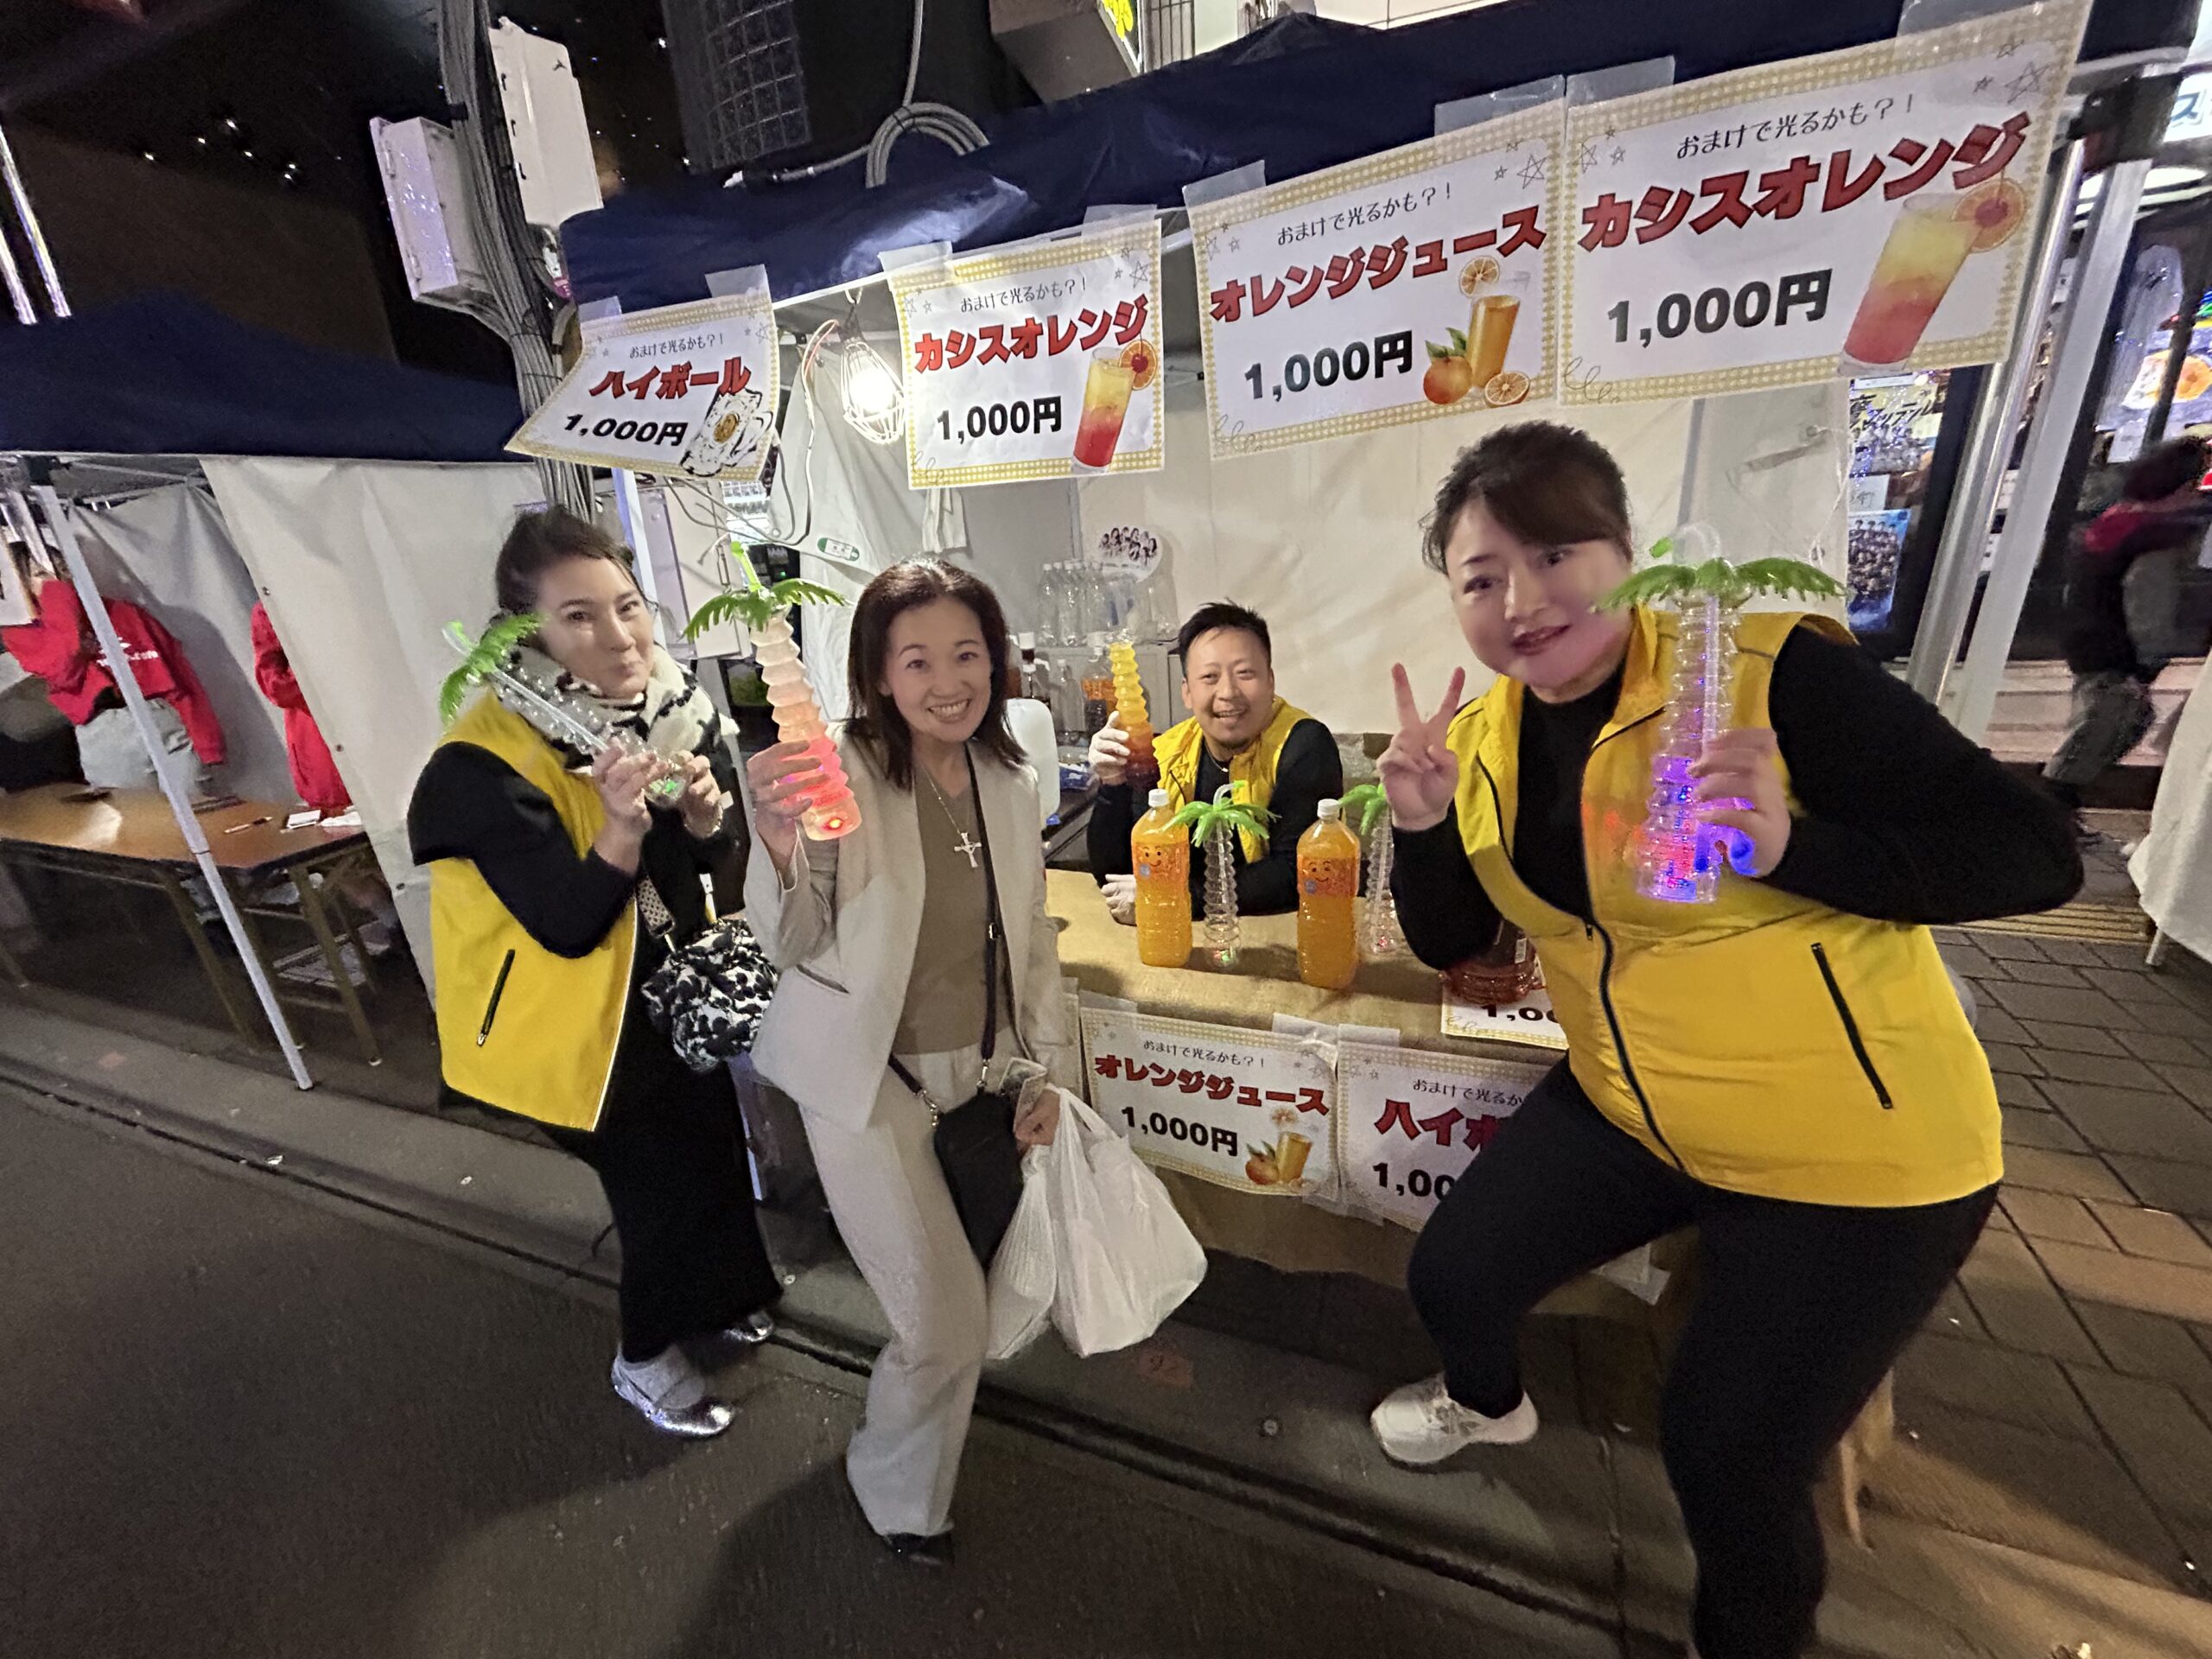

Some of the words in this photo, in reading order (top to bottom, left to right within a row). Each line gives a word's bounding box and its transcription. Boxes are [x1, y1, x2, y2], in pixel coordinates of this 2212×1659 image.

[1578, 111, 2030, 251] カシスオレンジ
[1210, 205, 1547, 322] オレンジジュース
[914, 294, 1148, 373] カシスオレンジ
[1607, 269, 1833, 348] 1,000円
[588, 357, 752, 400] ハイボール
[1244, 329, 1413, 402] 1,000円
[564, 414, 688, 447] 1,000円
[937, 396, 1063, 444] 1,000円
[1095, 1054, 1329, 1116] オレンジジュース
[1122, 1107, 1237, 1157] 1,000円
